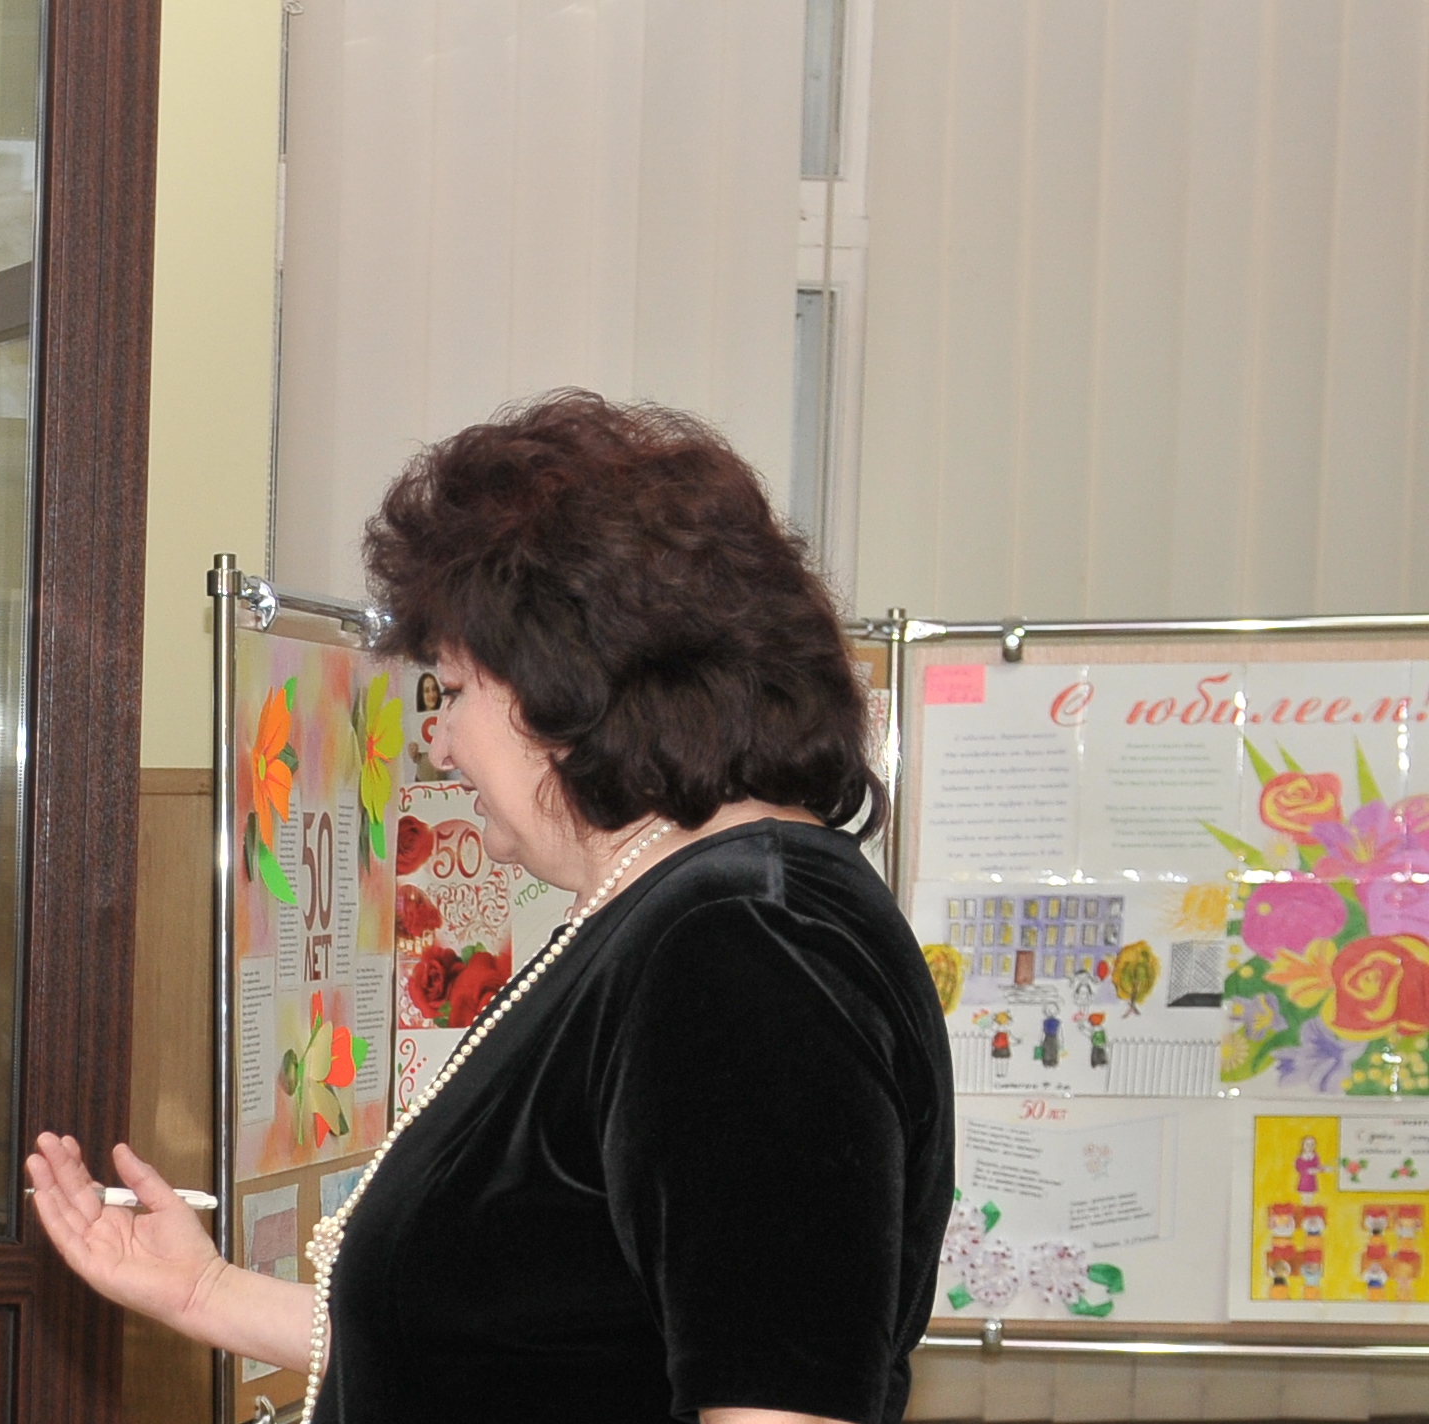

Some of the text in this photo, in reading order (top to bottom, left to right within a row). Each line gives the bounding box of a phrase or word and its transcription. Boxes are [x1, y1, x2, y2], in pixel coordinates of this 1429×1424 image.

[1050, 680, 1096, 727] С
[302, 811, 333, 931] 50
[432, 829, 483, 879] 50
[303, 933, 333, 982] ЛЕТ
